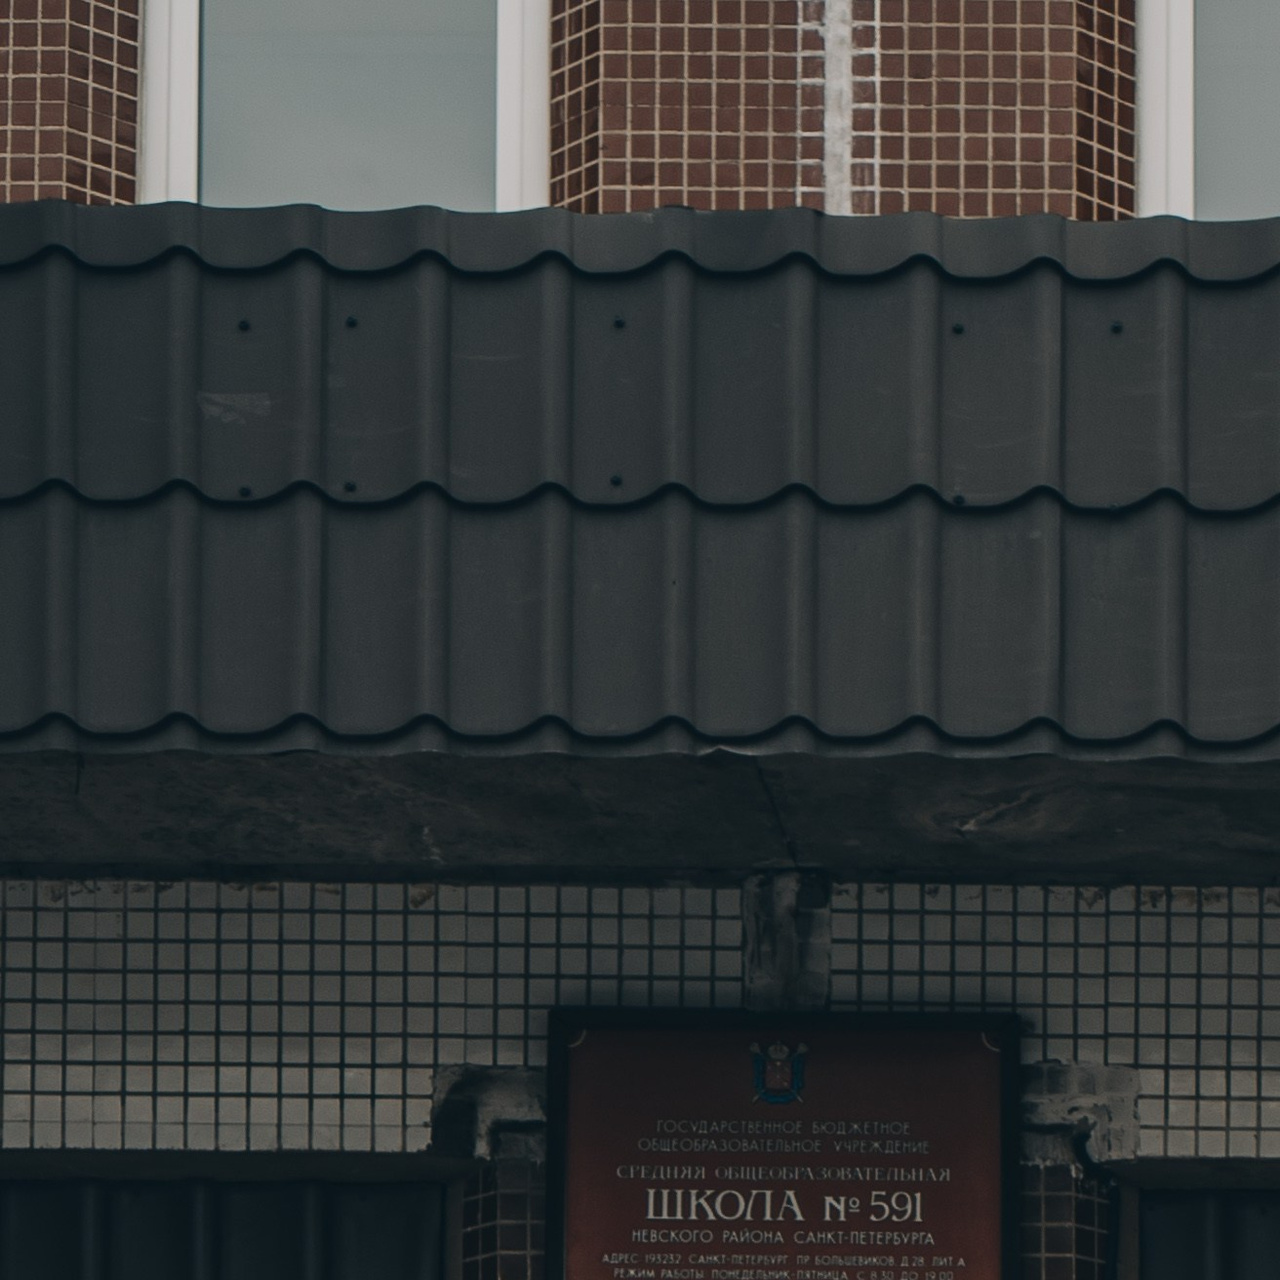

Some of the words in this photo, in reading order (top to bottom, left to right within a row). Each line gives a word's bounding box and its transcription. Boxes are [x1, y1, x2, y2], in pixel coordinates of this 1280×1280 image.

[656, 1119, 802, 1134] ГОСУДАРСТВЕННОЕ
[811, 1120, 910, 1135] БЮДЖЕТНОЕ
[638, 1138, 822, 1153] ОБЩЕОБРАЗОВАТЕЛЬНОЕ
[832, 1139, 930, 1154] УЧРЕЖДЕНИЕ
[616, 1164, 706, 1181] СРЕДНЯЯ
[714, 1166, 951, 1181] ОБЩЕОБРАЗОВАТЕЛЬНАЯ
[647, 1189, 805, 1221] ШКОЛА
[870, 1191, 923, 1222] 591
[631, 1228, 713, 1244] НЕВСКОГО
[722, 1227, 784, 1245] РАЙОНА
[793, 1230, 935, 1245] САНКТ-ПЕТЕРБУРГА
